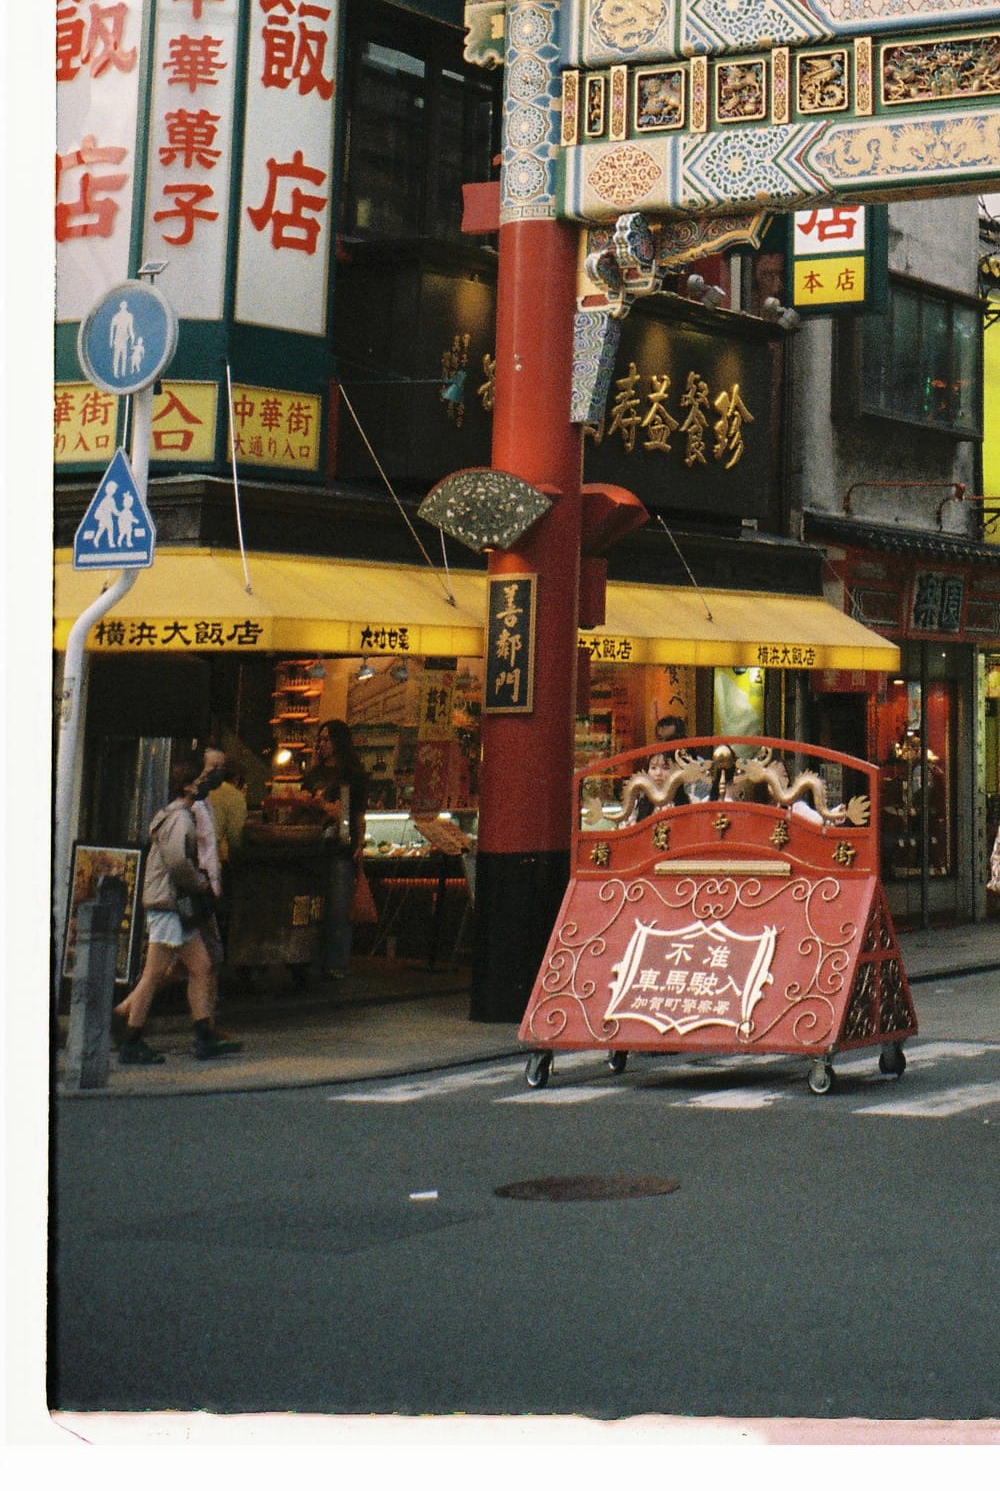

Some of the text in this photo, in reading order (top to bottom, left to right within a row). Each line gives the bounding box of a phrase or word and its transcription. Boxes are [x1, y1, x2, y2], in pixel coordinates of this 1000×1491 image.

[803, 268, 855, 294] 本店
[153, 390, 203, 452] 入口
[233, 394, 313, 436] 中華街
[233, 432, 311, 460] 大通り入口
[95, 620, 263, 646] 横浜大飯店
[757, 646, 816, 666] 横浜大飯店
[665, 943, 731, 968] 不准
[632, 968, 742, 996] 車馬駛入
[631, 996, 730, 1015] 加賀町警察署
